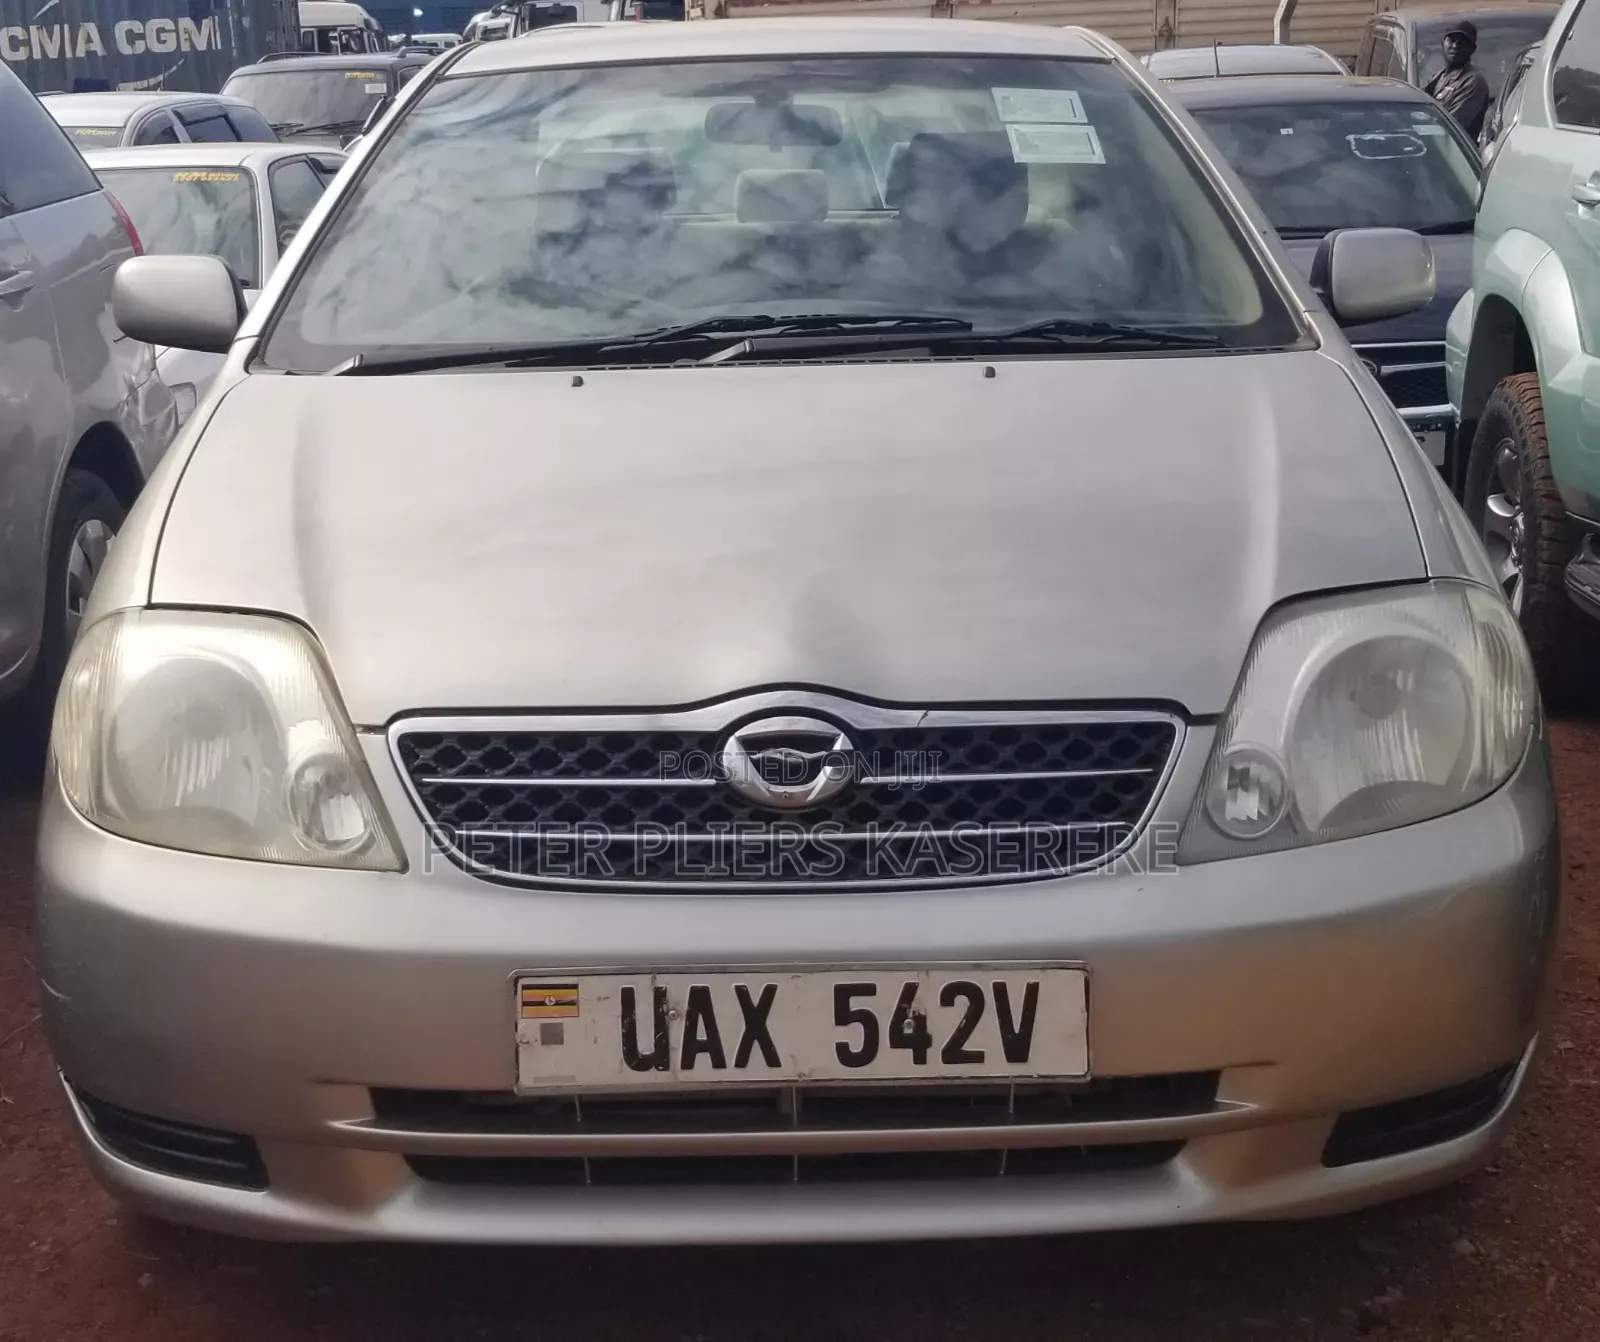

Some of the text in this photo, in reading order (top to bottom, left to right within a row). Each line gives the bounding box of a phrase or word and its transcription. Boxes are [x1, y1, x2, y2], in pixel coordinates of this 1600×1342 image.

[0, 15, 222, 61] CMA CGM
[620, 981, 1040, 1072] UAX 542V
